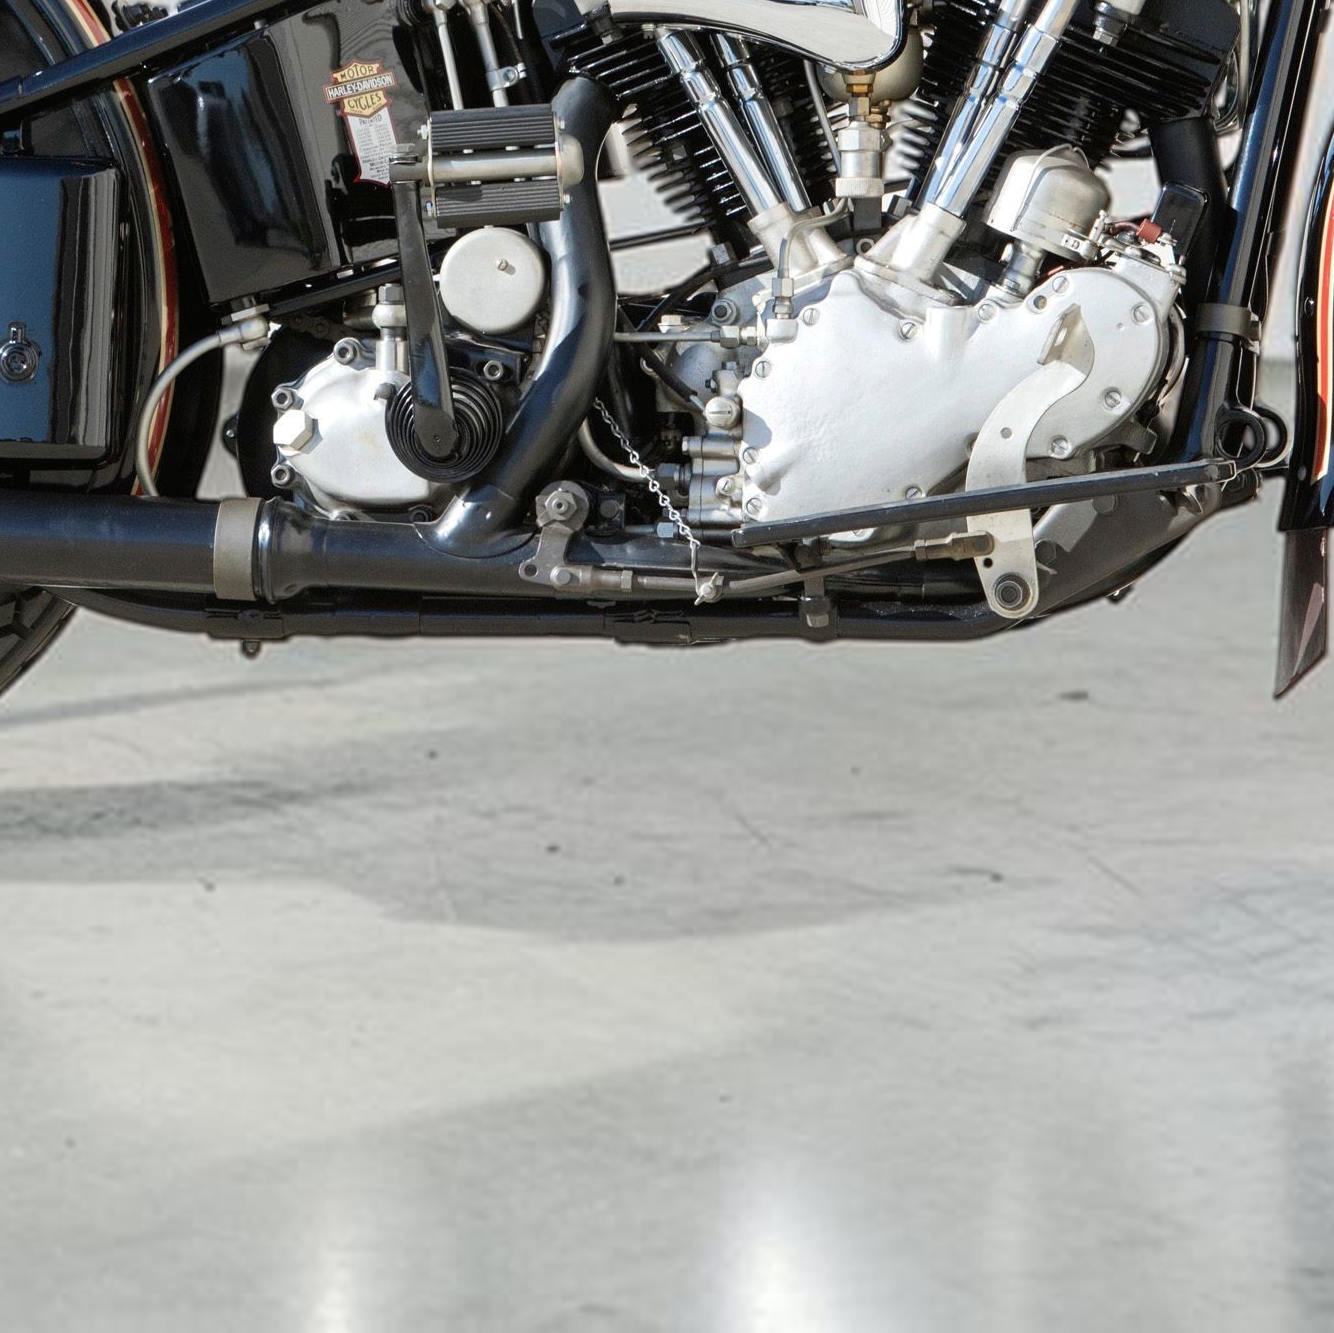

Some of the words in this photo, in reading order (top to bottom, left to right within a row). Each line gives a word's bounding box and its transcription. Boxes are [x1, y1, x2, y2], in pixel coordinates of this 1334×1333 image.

[340, 65, 374, 80] MOTOR
[327, 73, 393, 99] HARLEY-DAVIDSON
[347, 92, 382, 110] CYCLES
